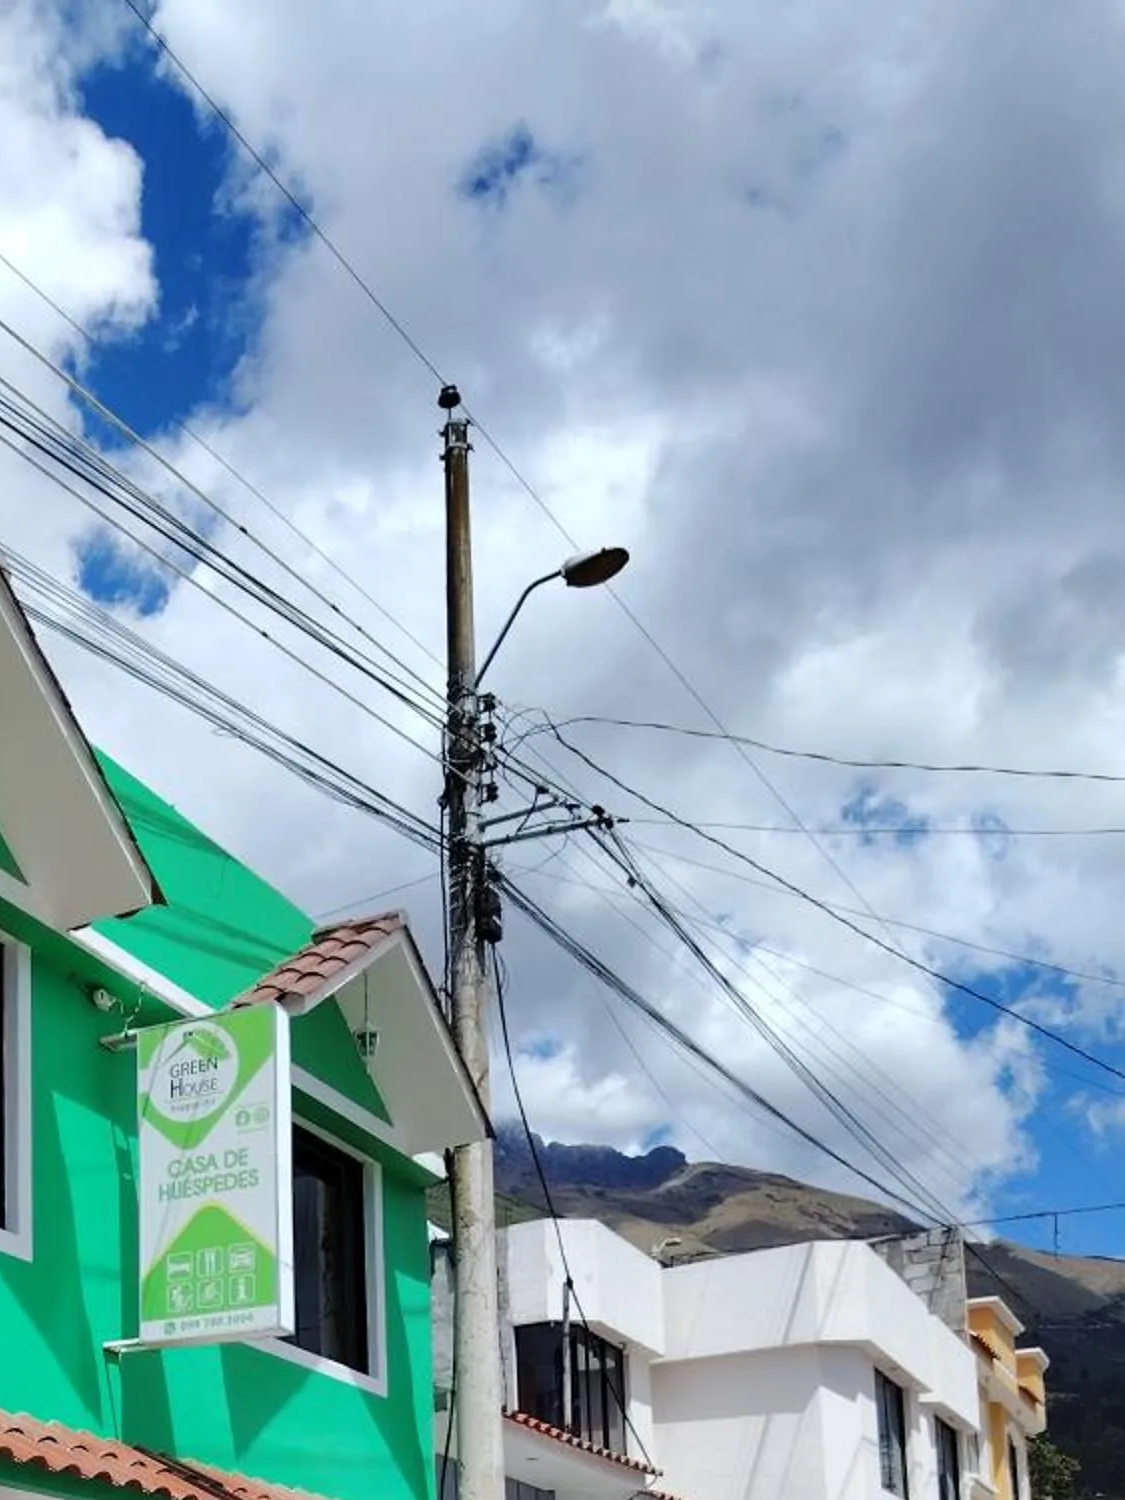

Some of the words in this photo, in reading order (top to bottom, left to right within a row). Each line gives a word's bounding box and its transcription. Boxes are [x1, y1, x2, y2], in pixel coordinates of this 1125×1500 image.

[170, 1057, 218, 1078] GREEN
[170, 1078, 219, 1098] HOUSE
[167, 1154, 218, 1178] CASA
[224, 1148, 249, 1169] DE
